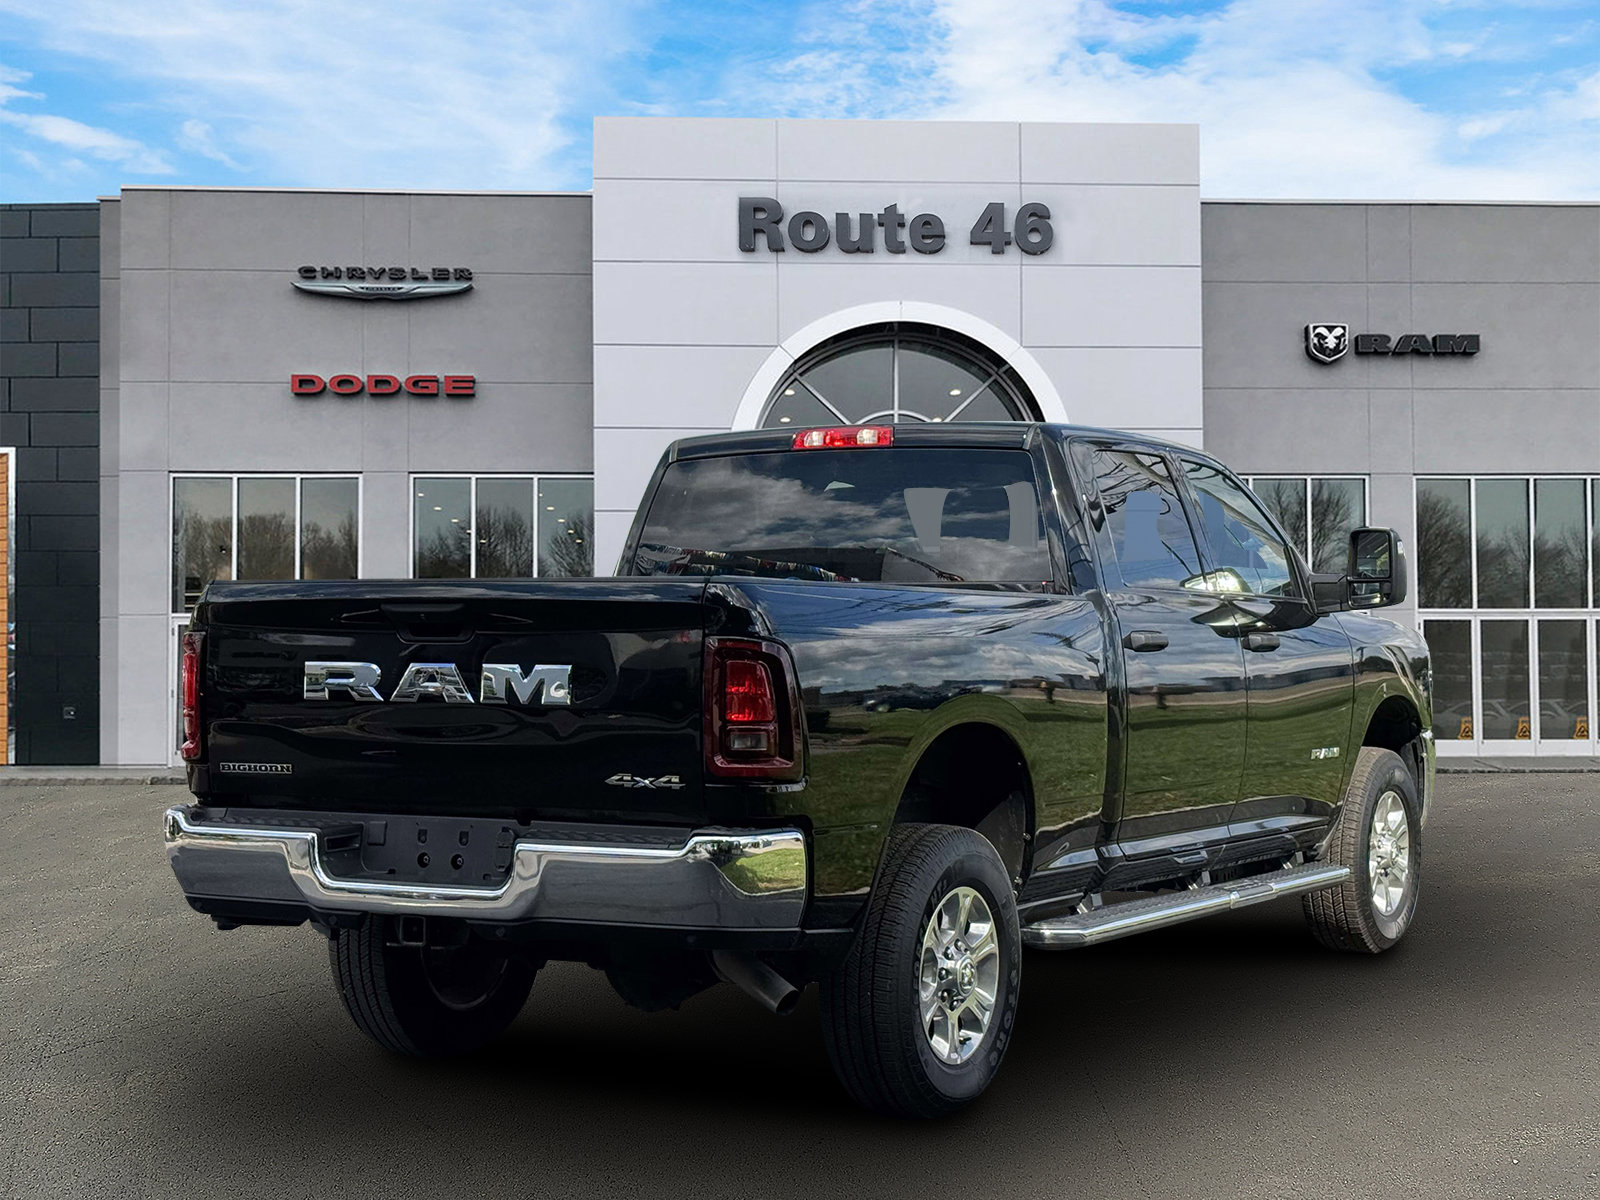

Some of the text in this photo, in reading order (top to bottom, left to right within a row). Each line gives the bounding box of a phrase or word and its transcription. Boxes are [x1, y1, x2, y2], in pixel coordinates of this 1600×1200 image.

[738, 197, 1054, 255] Route 46
[297, 265, 474, 281] CHRYSLER
[1354, 333, 1480, 356] RAM
[290, 373, 476, 398] DODGE
[303, 661, 573, 705] RAM
[219, 762, 293, 774] BIGHORN
[604, 773, 686, 789] 4x4
